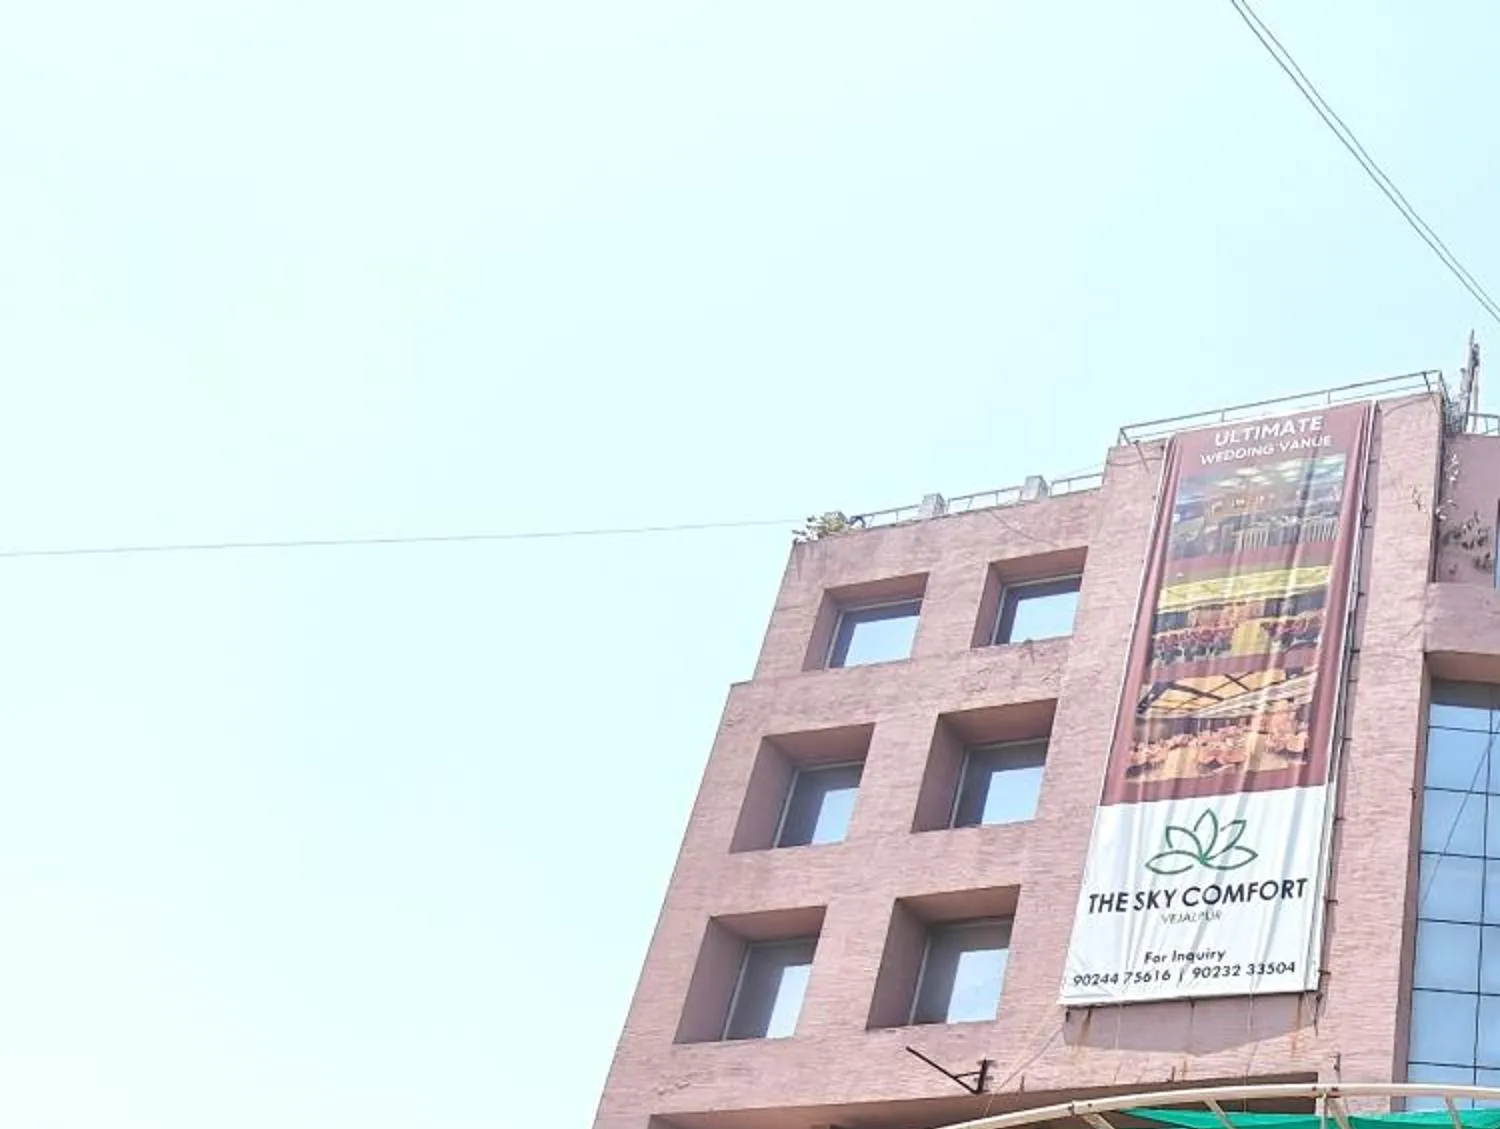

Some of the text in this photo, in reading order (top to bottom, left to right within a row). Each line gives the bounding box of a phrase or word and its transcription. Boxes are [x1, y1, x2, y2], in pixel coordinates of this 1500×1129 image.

[1214, 415, 1325, 447] ULTIMATE
[1200, 434, 1332, 465] WEDDING VANUE
[1088, 878, 1309, 915] THE SKY COMFORT
[1143, 948, 1227, 966] For Inquiry
[1073, 972, 1120, 987] 90244
[1123, 969, 1172, 985] 75616
[1192, 965, 1241, 980] 90232
[1246, 961, 1296, 977] 33504
